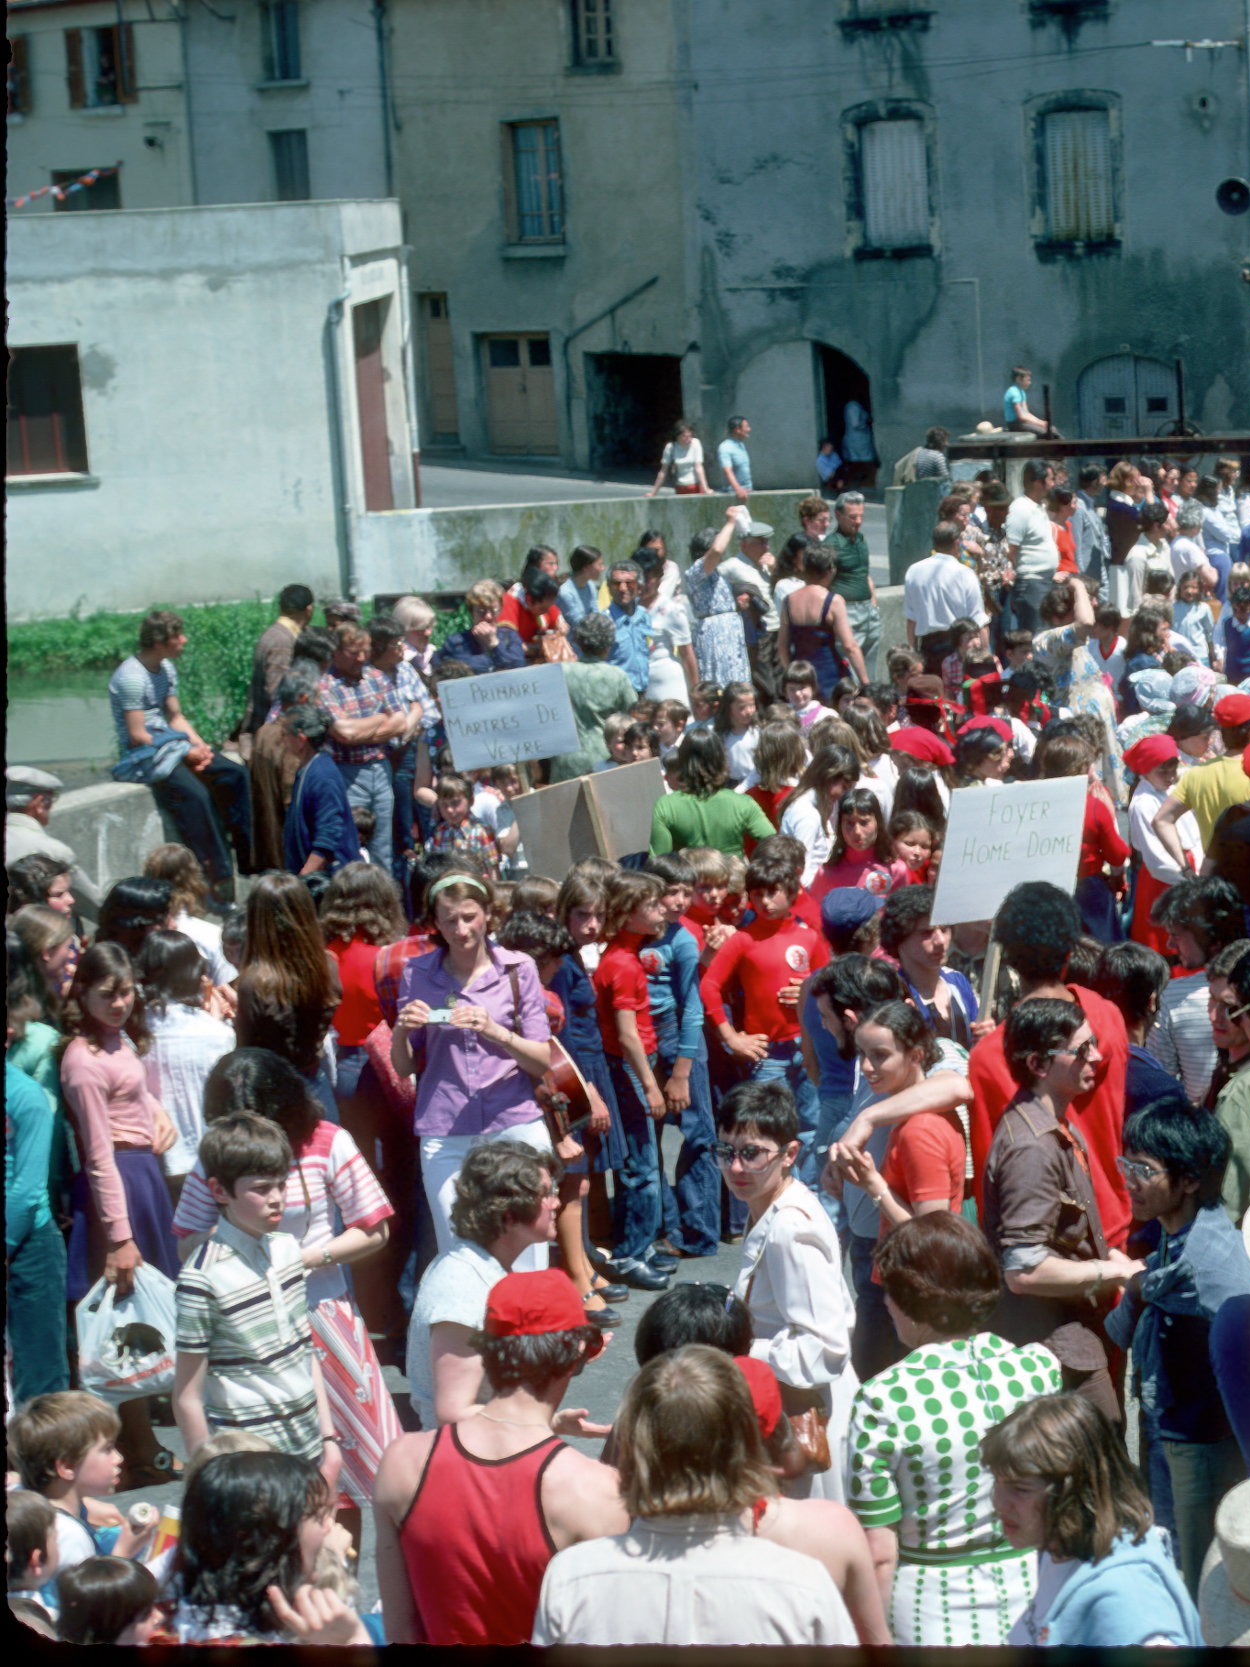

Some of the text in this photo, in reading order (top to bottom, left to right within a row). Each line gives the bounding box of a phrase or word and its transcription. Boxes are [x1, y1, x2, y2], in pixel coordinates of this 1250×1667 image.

[470, 681, 541, 704] PRIMAIRE
[447, 703, 561, 739] MARTRES DE
[483, 739, 544, 762] VEYRE
[988, 793, 1050, 835] FOYER
[961, 831, 1075, 866] HOME DOME
